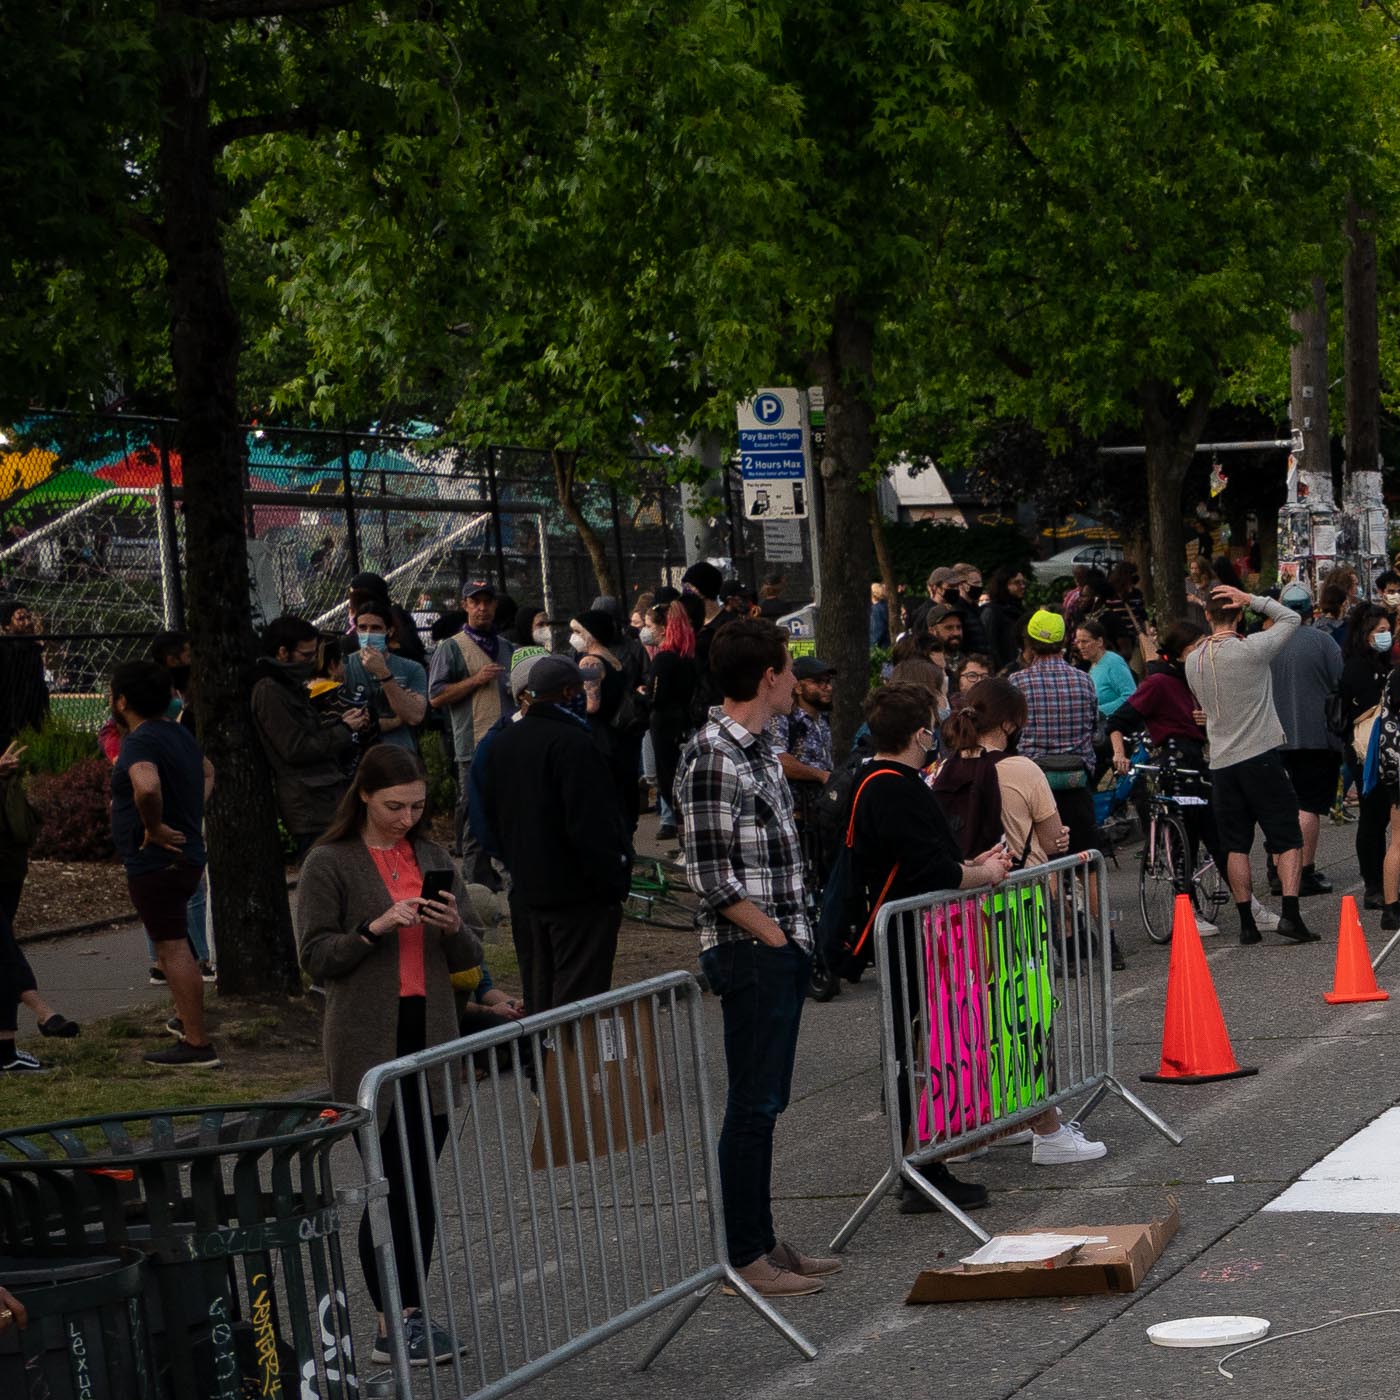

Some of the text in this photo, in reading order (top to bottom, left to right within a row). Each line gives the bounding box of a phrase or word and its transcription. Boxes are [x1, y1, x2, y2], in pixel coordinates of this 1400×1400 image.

[761, 399, 777, 419] P
[742, 432, 756, 442] Pay
[744, 457, 801, 470] 2 Hours Max
